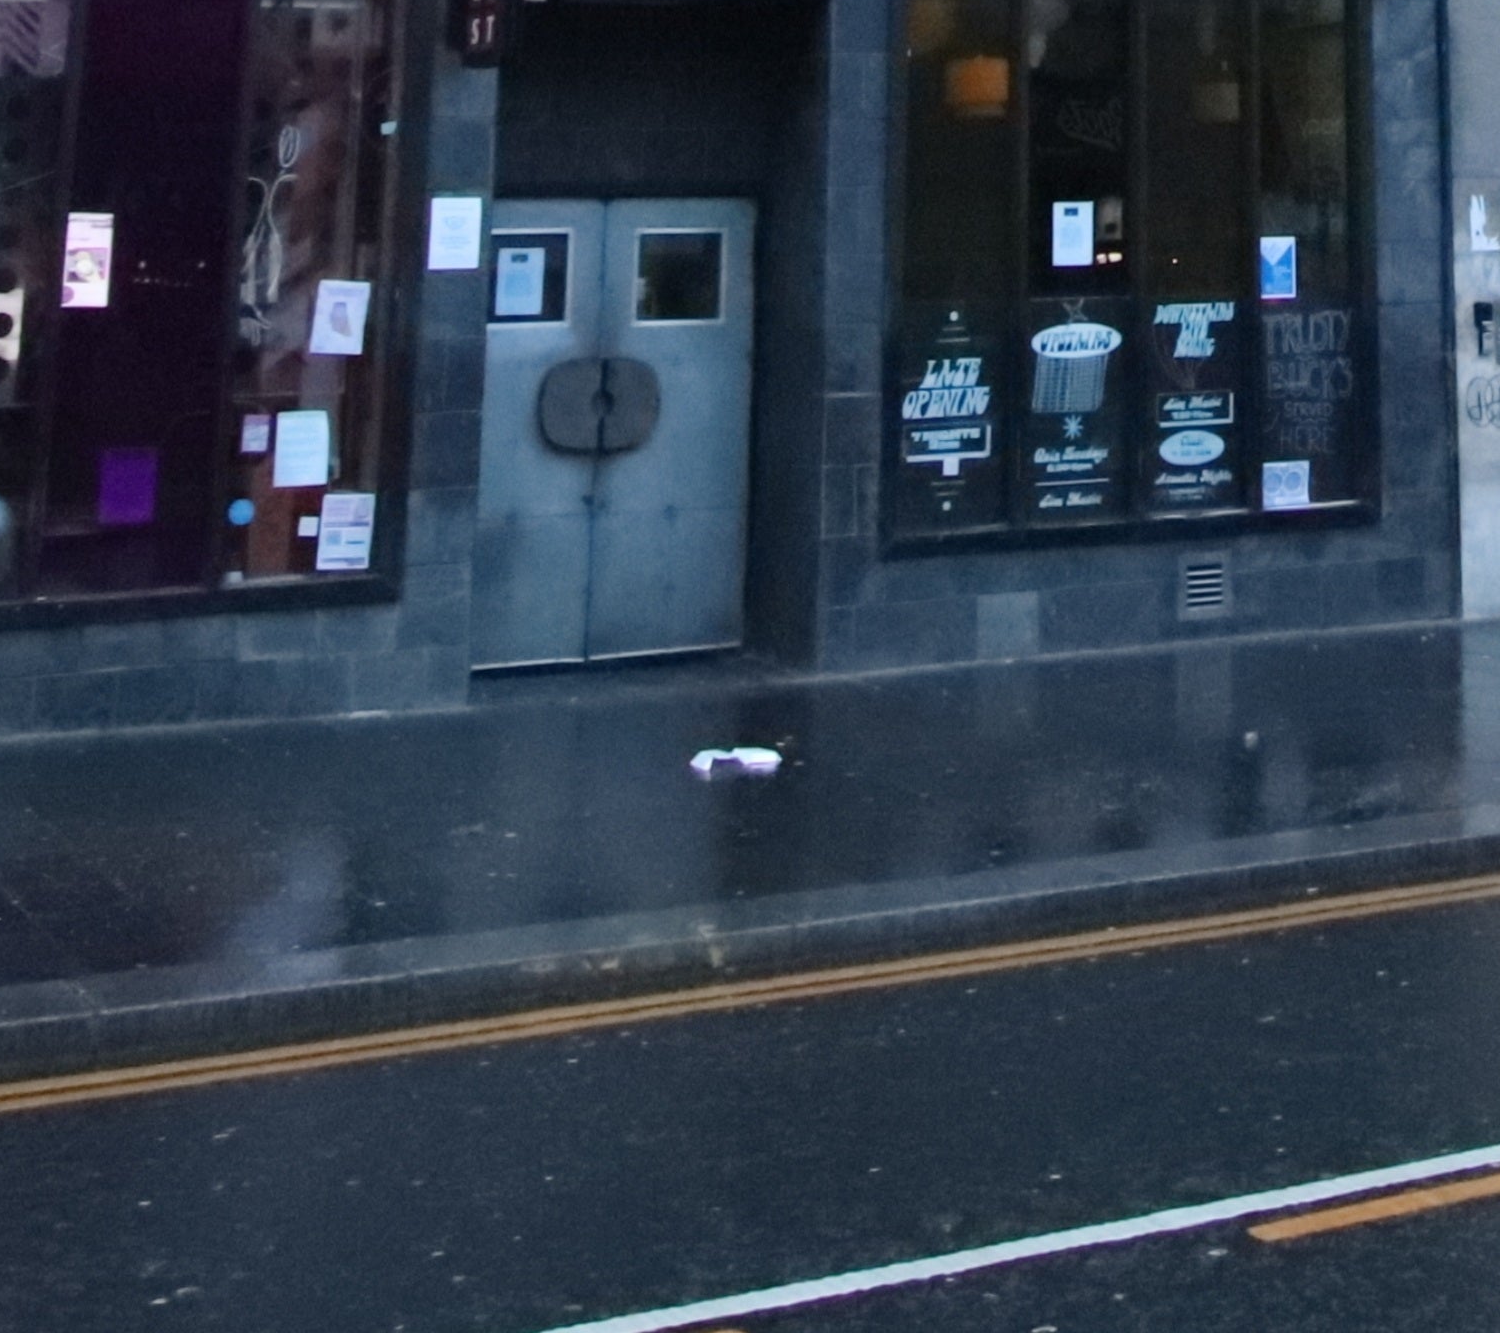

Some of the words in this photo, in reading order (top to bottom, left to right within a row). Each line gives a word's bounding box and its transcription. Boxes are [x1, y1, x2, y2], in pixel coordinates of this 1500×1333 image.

[1039, 330, 1114, 353] UPSTAIRS
[919, 357, 982, 389] LATE
[901, 385, 991, 420] OPENING
